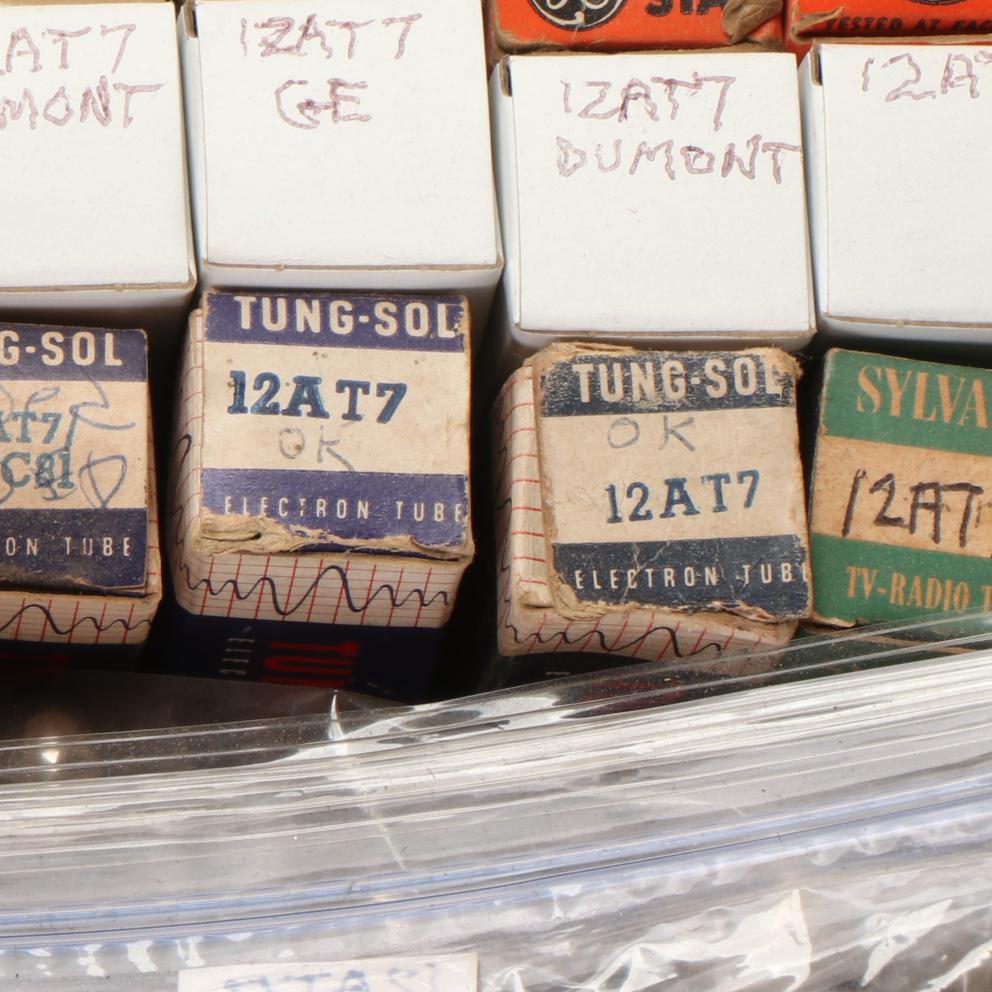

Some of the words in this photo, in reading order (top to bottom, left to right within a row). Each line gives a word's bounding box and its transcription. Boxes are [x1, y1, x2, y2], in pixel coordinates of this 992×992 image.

[239, 12, 423, 60] 12AT7
[825, 16, 898, 32] TESTED
[862, 50, 992, 102] 12A
[274, 78, 372, 129] GE
[562, 72, 737, 131] 12AT7
[555, 134, 802, 184] DUMONT
[234, 296, 456, 338] TUNG-SOL
[227, 371, 408, 424] 12AT7
[572, 357, 782, 403] TUNG-SOL
[855, 364, 992, 429] SYLVA
[278, 425, 356, 472] OK
[607, 416, 696, 451] OK
[224, 496, 370, 520] ELECTRON
[395, 500, 468, 523] TUBE
[606, 470, 760, 523] 12AT7
[842, 469, 984, 549] 12AT
[64, 537, 131, 556] TUBE
[575, 564, 718, 590] ELECTRON
[846, 565, 971, 613] TV-RADIO
